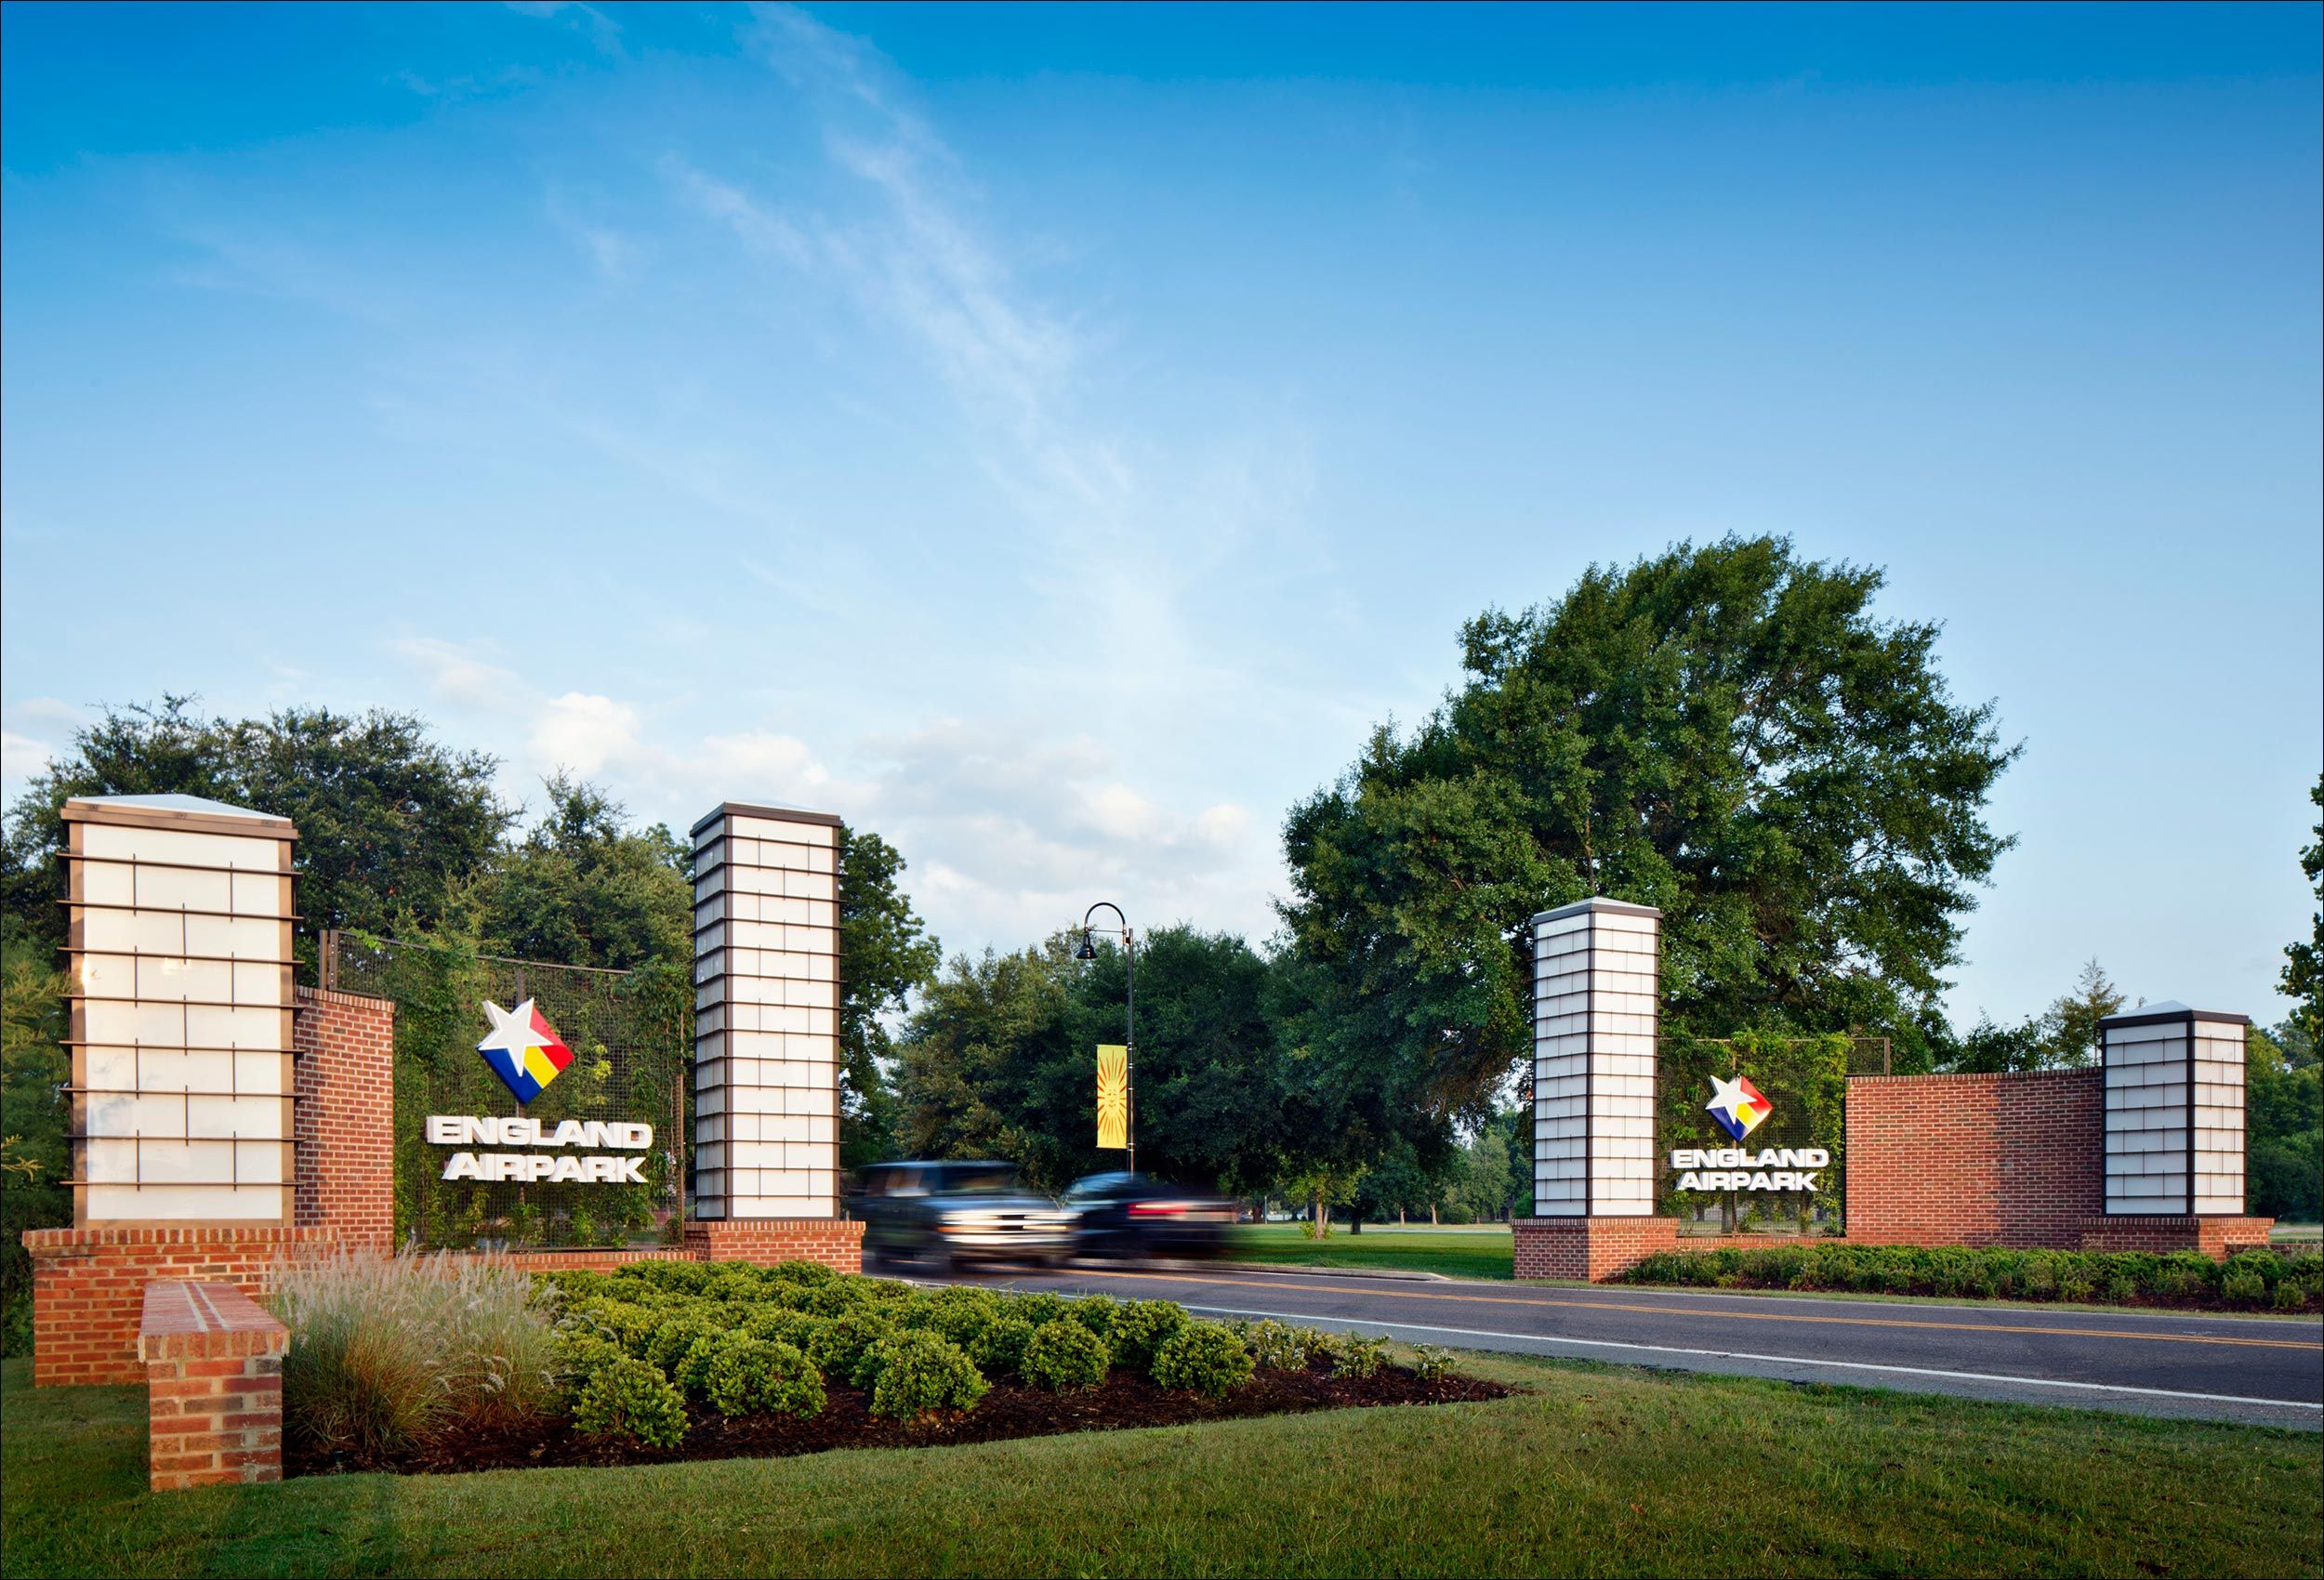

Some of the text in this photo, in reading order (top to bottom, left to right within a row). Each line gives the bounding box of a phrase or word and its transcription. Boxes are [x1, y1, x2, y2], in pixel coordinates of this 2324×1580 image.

[426, 1115, 653, 1150] ENGLAND
[442, 1152, 648, 1183] AIRPARK
[1671, 1148, 1829, 1169] ENGLAND
[1676, 1171, 1819, 1192] AIRPARK
